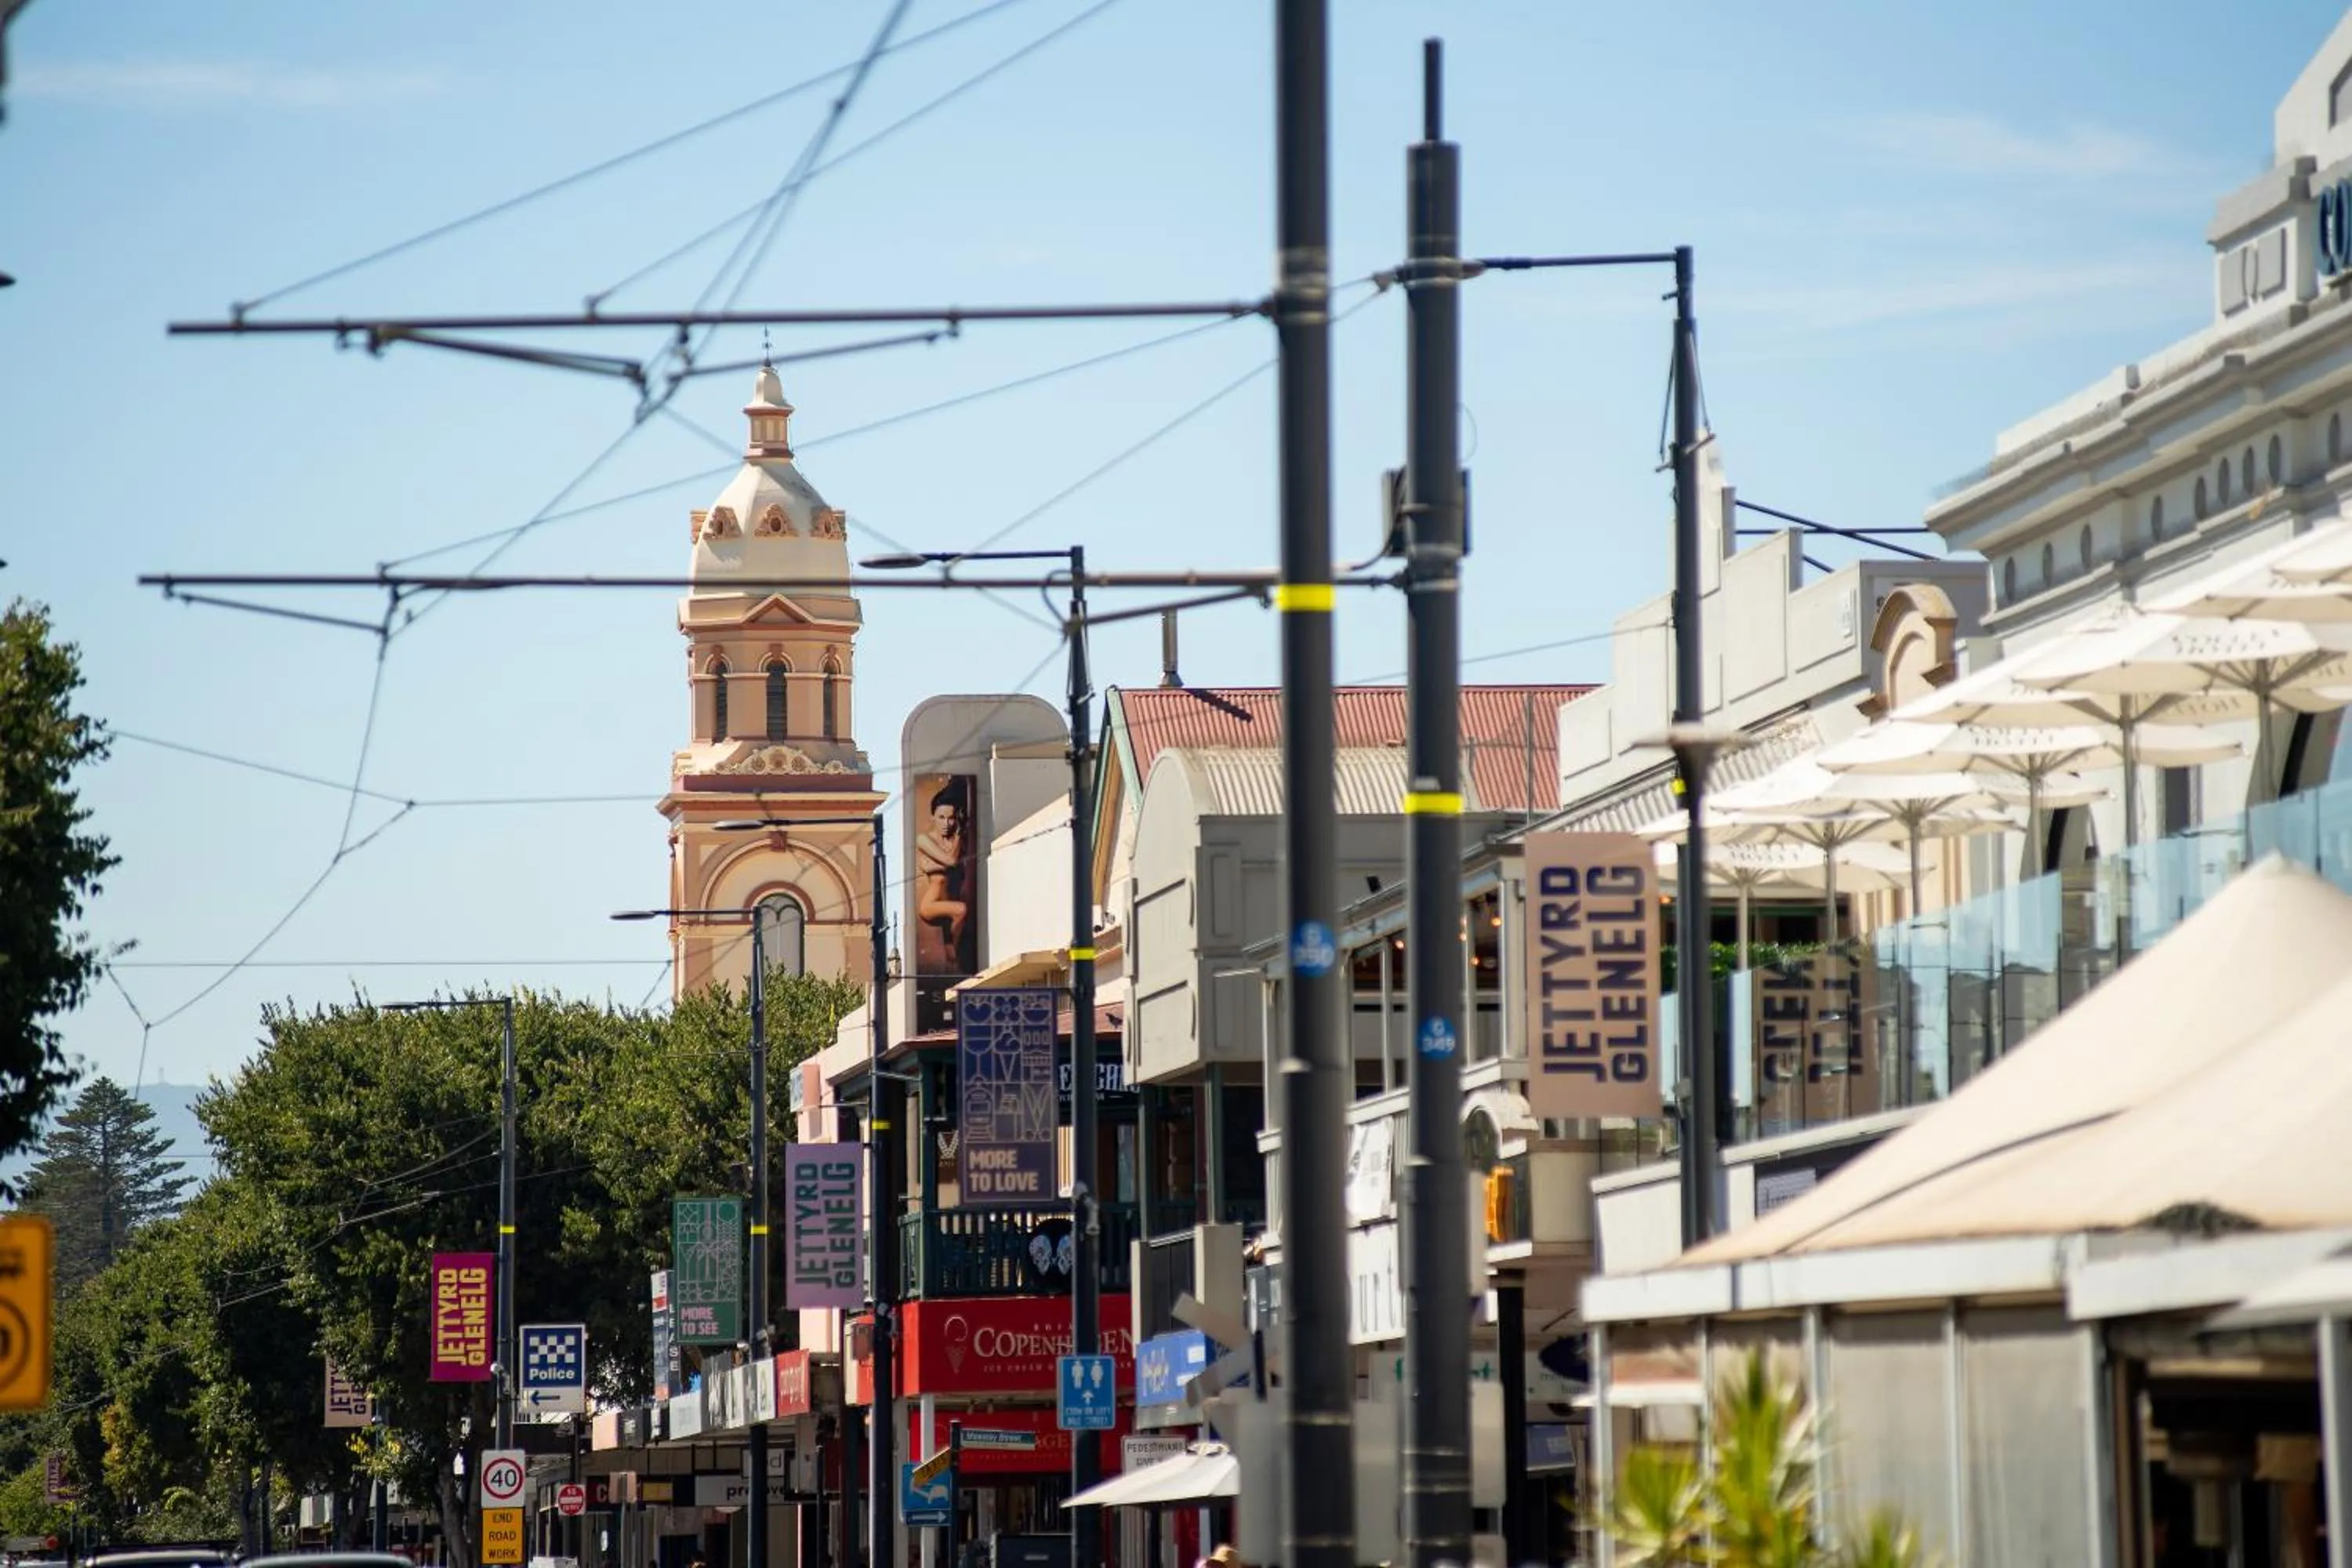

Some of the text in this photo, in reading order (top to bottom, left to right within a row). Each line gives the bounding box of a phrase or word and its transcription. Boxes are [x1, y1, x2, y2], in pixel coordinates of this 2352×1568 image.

[1586, 866, 1648, 1083] GLENELG
[969, 1149, 1017, 1170] MORE
[969, 1171, 1039, 1192] TO LOVE
[821, 1163, 856, 1288] GLENELG
[459, 1267, 487, 1366] GLENELG
[681, 1307, 714, 1320] MORE
[681, 1322, 720, 1336] TO SEE
[974, 1327, 1134, 1357] COPENHEN
[529, 1368, 575, 1381] Police
[490, 1468, 517, 1487] 40
[492, 1512, 512, 1523] END
[488, 1531, 517, 1541] ROAD
[488, 1548, 517, 1559] WORK
